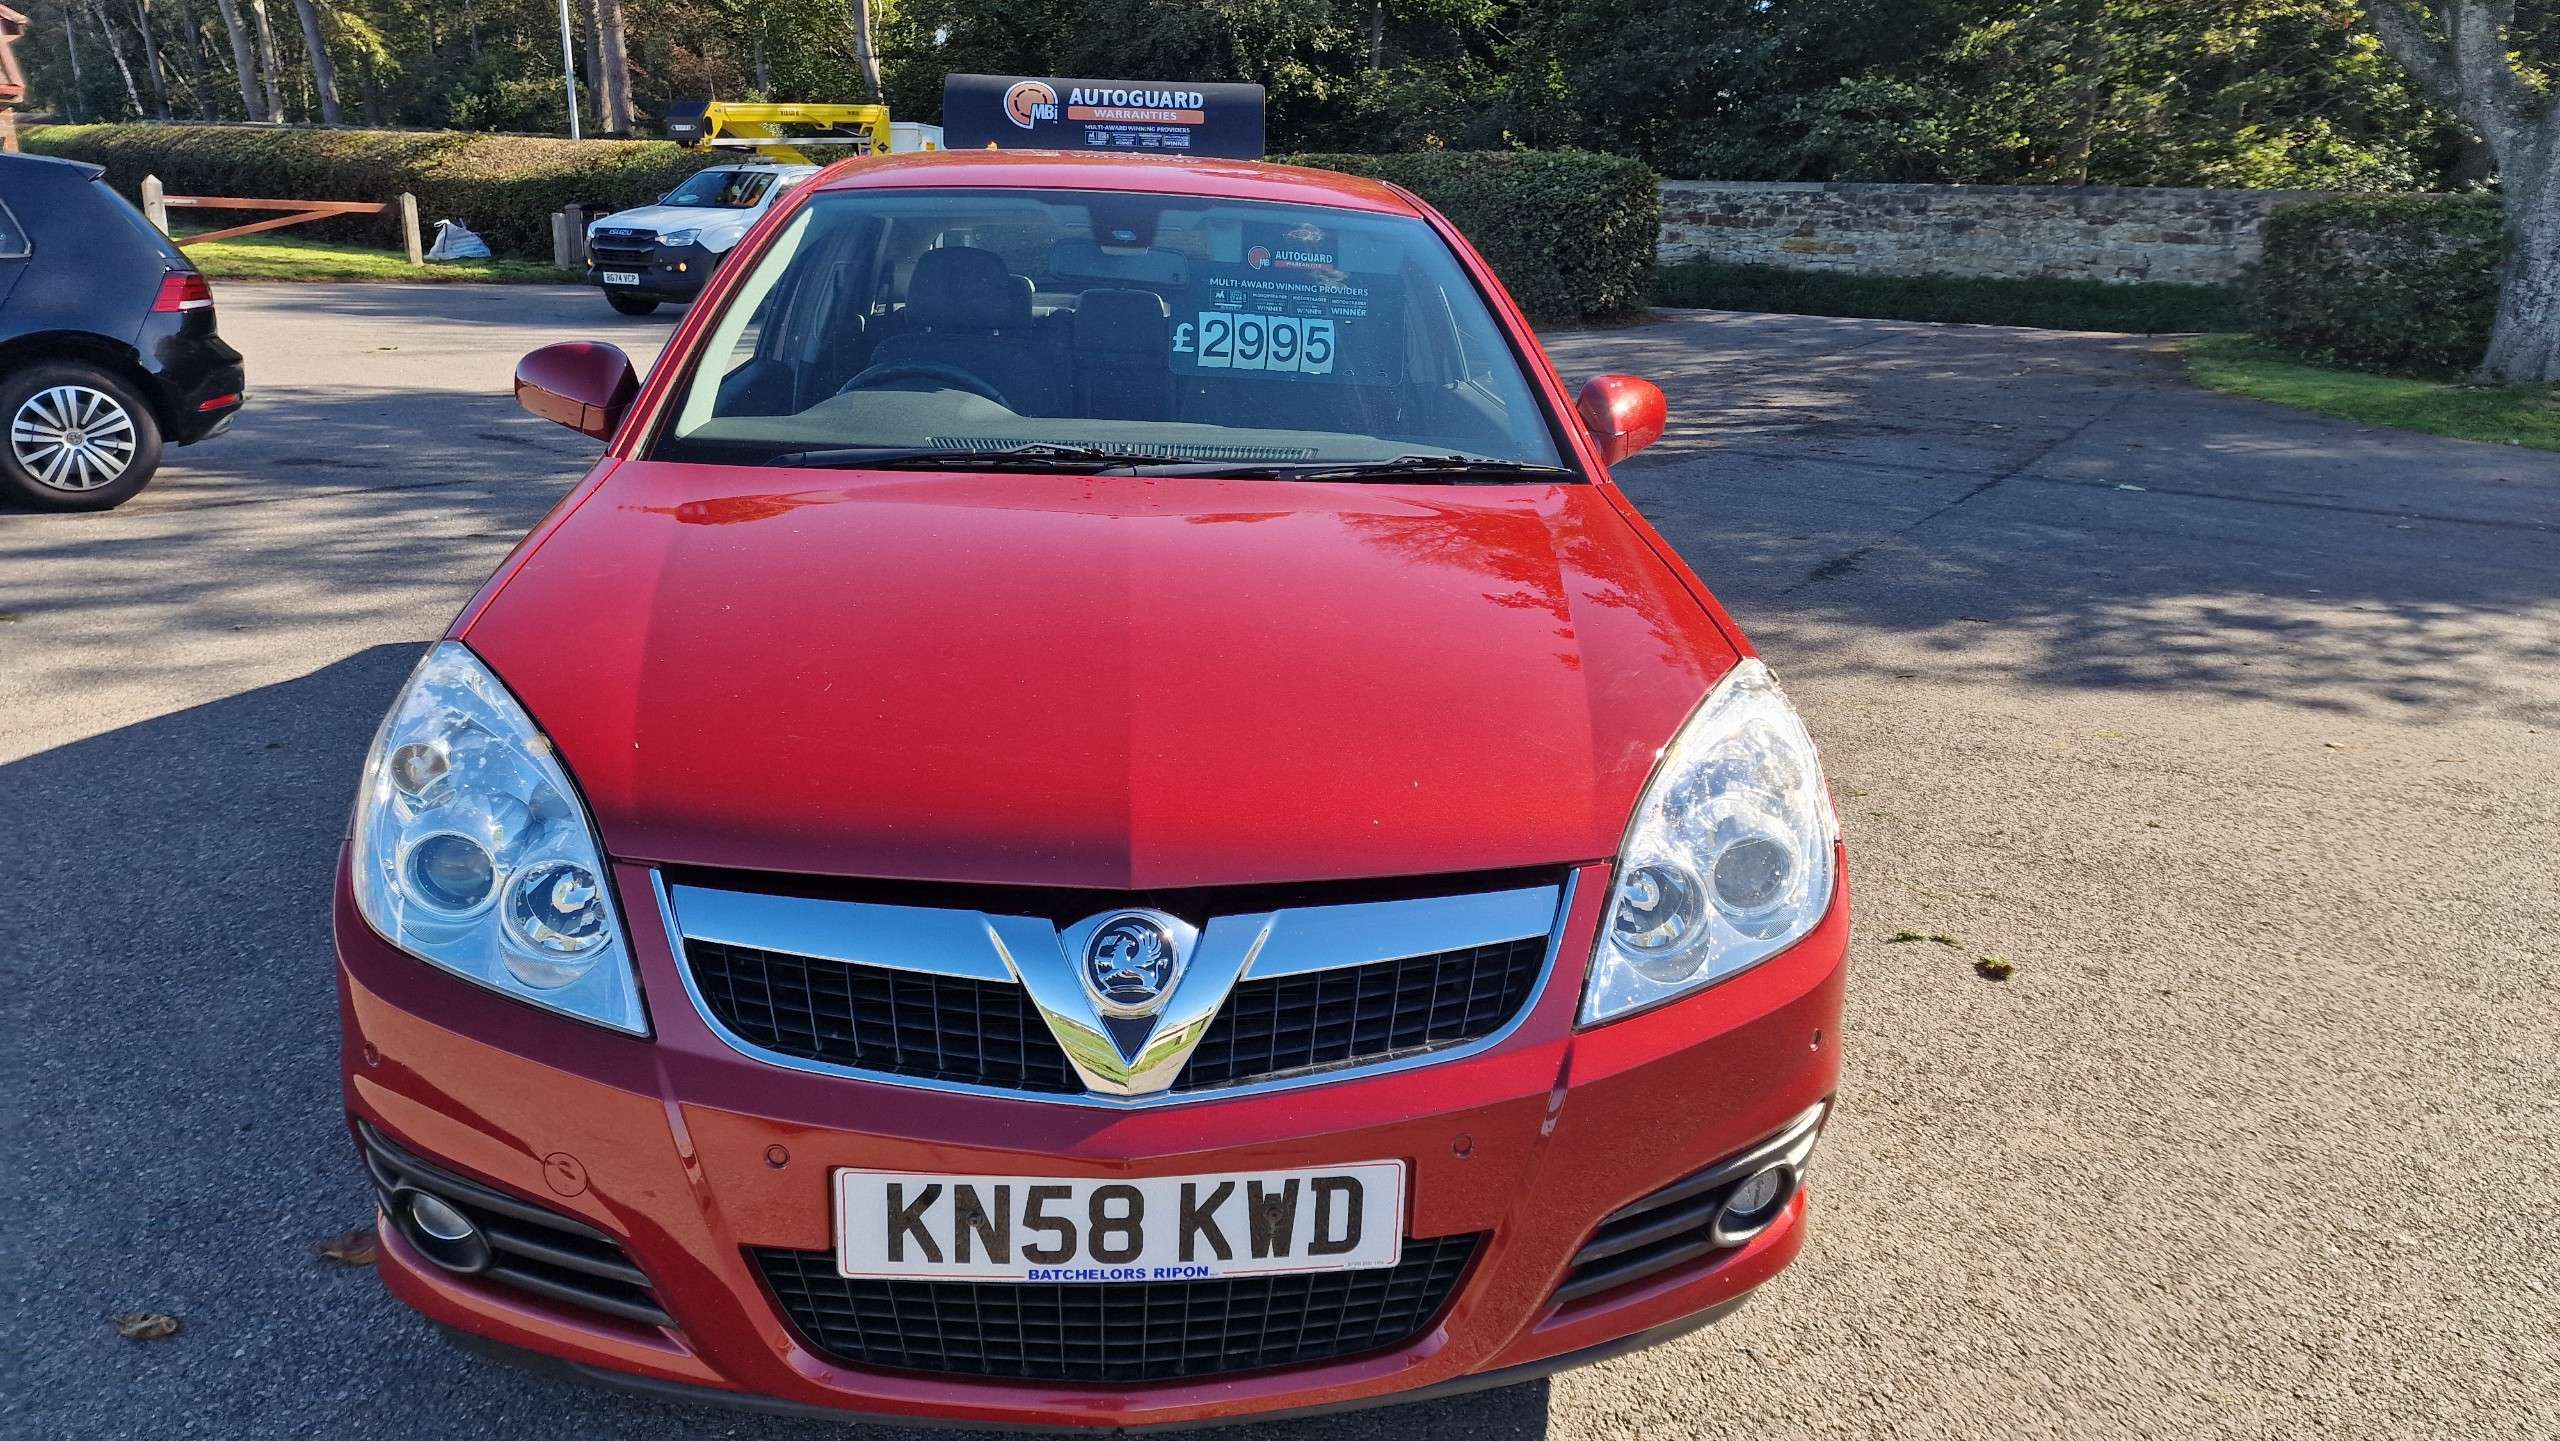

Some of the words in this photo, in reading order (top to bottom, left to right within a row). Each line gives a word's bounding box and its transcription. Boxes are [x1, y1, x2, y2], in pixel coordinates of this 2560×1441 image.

[1068, 87, 1204, 109] AUTOGUARD
[1093, 109, 1177, 121] WARRANTIES
[1275, 250, 1333, 264] AUTOGUARD
[1209, 277, 1275, 291] MULTI-AWARD
[1275, 281, 1317, 294] WINNING
[1319, 285, 1369, 297] PROVIDERS
[1331, 307, 1367, 316] WINNER
[886, 1181, 1145, 1265] KN58
[1178, 1175, 1365, 1263] KWD
[1027, 1267, 1147, 1281] BATCHELORS
[1153, 1265, 1210, 1279] RIPON
